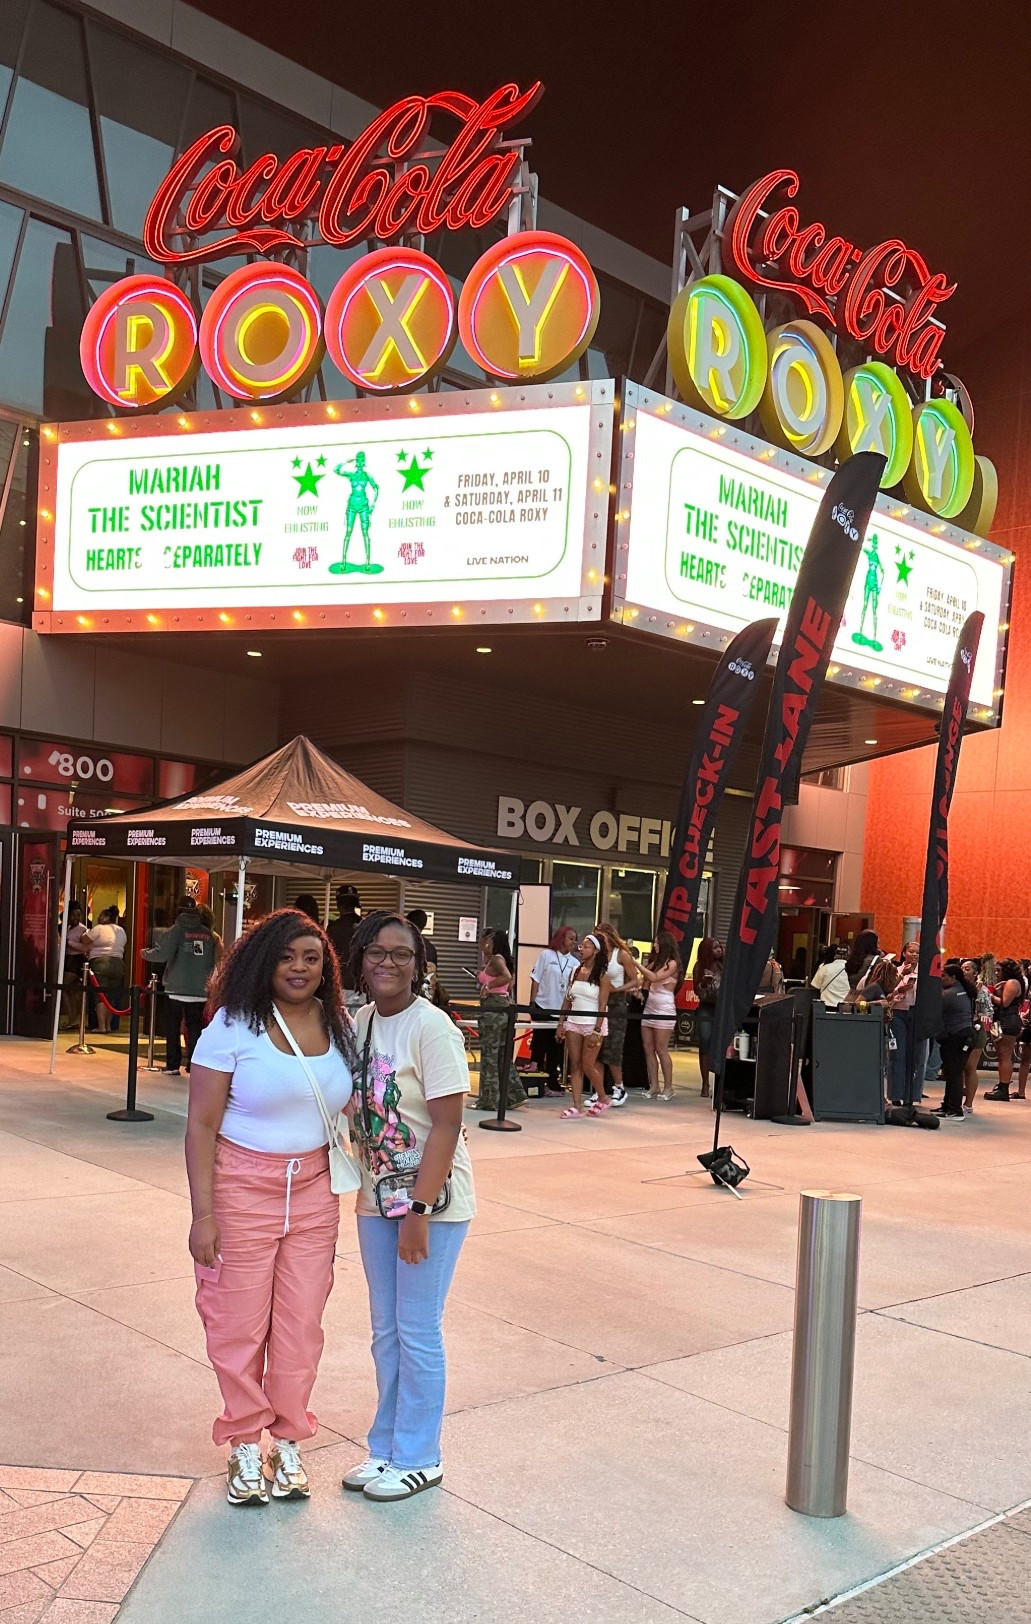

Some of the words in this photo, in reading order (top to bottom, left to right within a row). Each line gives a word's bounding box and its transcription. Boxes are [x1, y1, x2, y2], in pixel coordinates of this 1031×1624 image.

[144, 80, 545, 265] Coca-Cola
[728, 169, 958, 379] Coca-Cola
[112, 258, 573, 396] ROXY
[683, 296, 957, 505] ROXY
[129, 464, 221, 495] MARIAH
[458, 473, 499, 488] FRIDAY,
[503, 470, 533, 486] APRIL
[538, 469, 550, 483] 10
[444, 495, 451, 507] &
[455, 490, 514, 506] SATURDAY,
[517, 488, 548, 503] APRIL
[553, 487, 563, 502] 11
[719, 474, 788, 528] MARIAH
[88, 505, 130, 533] THE
[140, 499, 263, 531] SCIENTIST
[455, 508, 516, 525] COCA-COLA
[519, 507, 548, 522] ROXY
[684, 503, 719, 544] THE
[726, 520, 804, 572] SCIENTIS
[86, 547, 143, 571] HEARTS
[466, 557, 488, 566] LIVE
[489, 555, 529, 564] NATION
[680, 551, 727, 589] HEARTS
[743, 572, 794, 609] SEPARAT
[58, 805, 87, 818] Suite
[287, 801, 370, 815] PREMIUM
[299, 810, 412, 828] EXPERIENCES
[663, 885, 692, 942] VIP
[679, 704, 740, 879] CHECK-IN
[72, 830, 96, 838] PREMIUM
[128, 829, 155, 838] PREMIUM
[191, 827, 222, 837] PREMIUM
[255, 828, 302, 844] PREMIUM
[497, 795, 582, 847] BOX
[589, 810, 716, 863] OFFI
[72, 837, 106, 846] EXPERIENCES
[127, 837, 166, 846] EXPERIENCES
[190, 835, 236, 845] EXPERIENCES
[254, 837, 324, 855] EXPERIENCES
[363, 844, 405, 857] PREMIUM
[362, 852, 423, 868] EXPERIENCES
[458, 857, 496, 870] PREMIUM
[457, 865, 512, 880] EXPERIENCES
